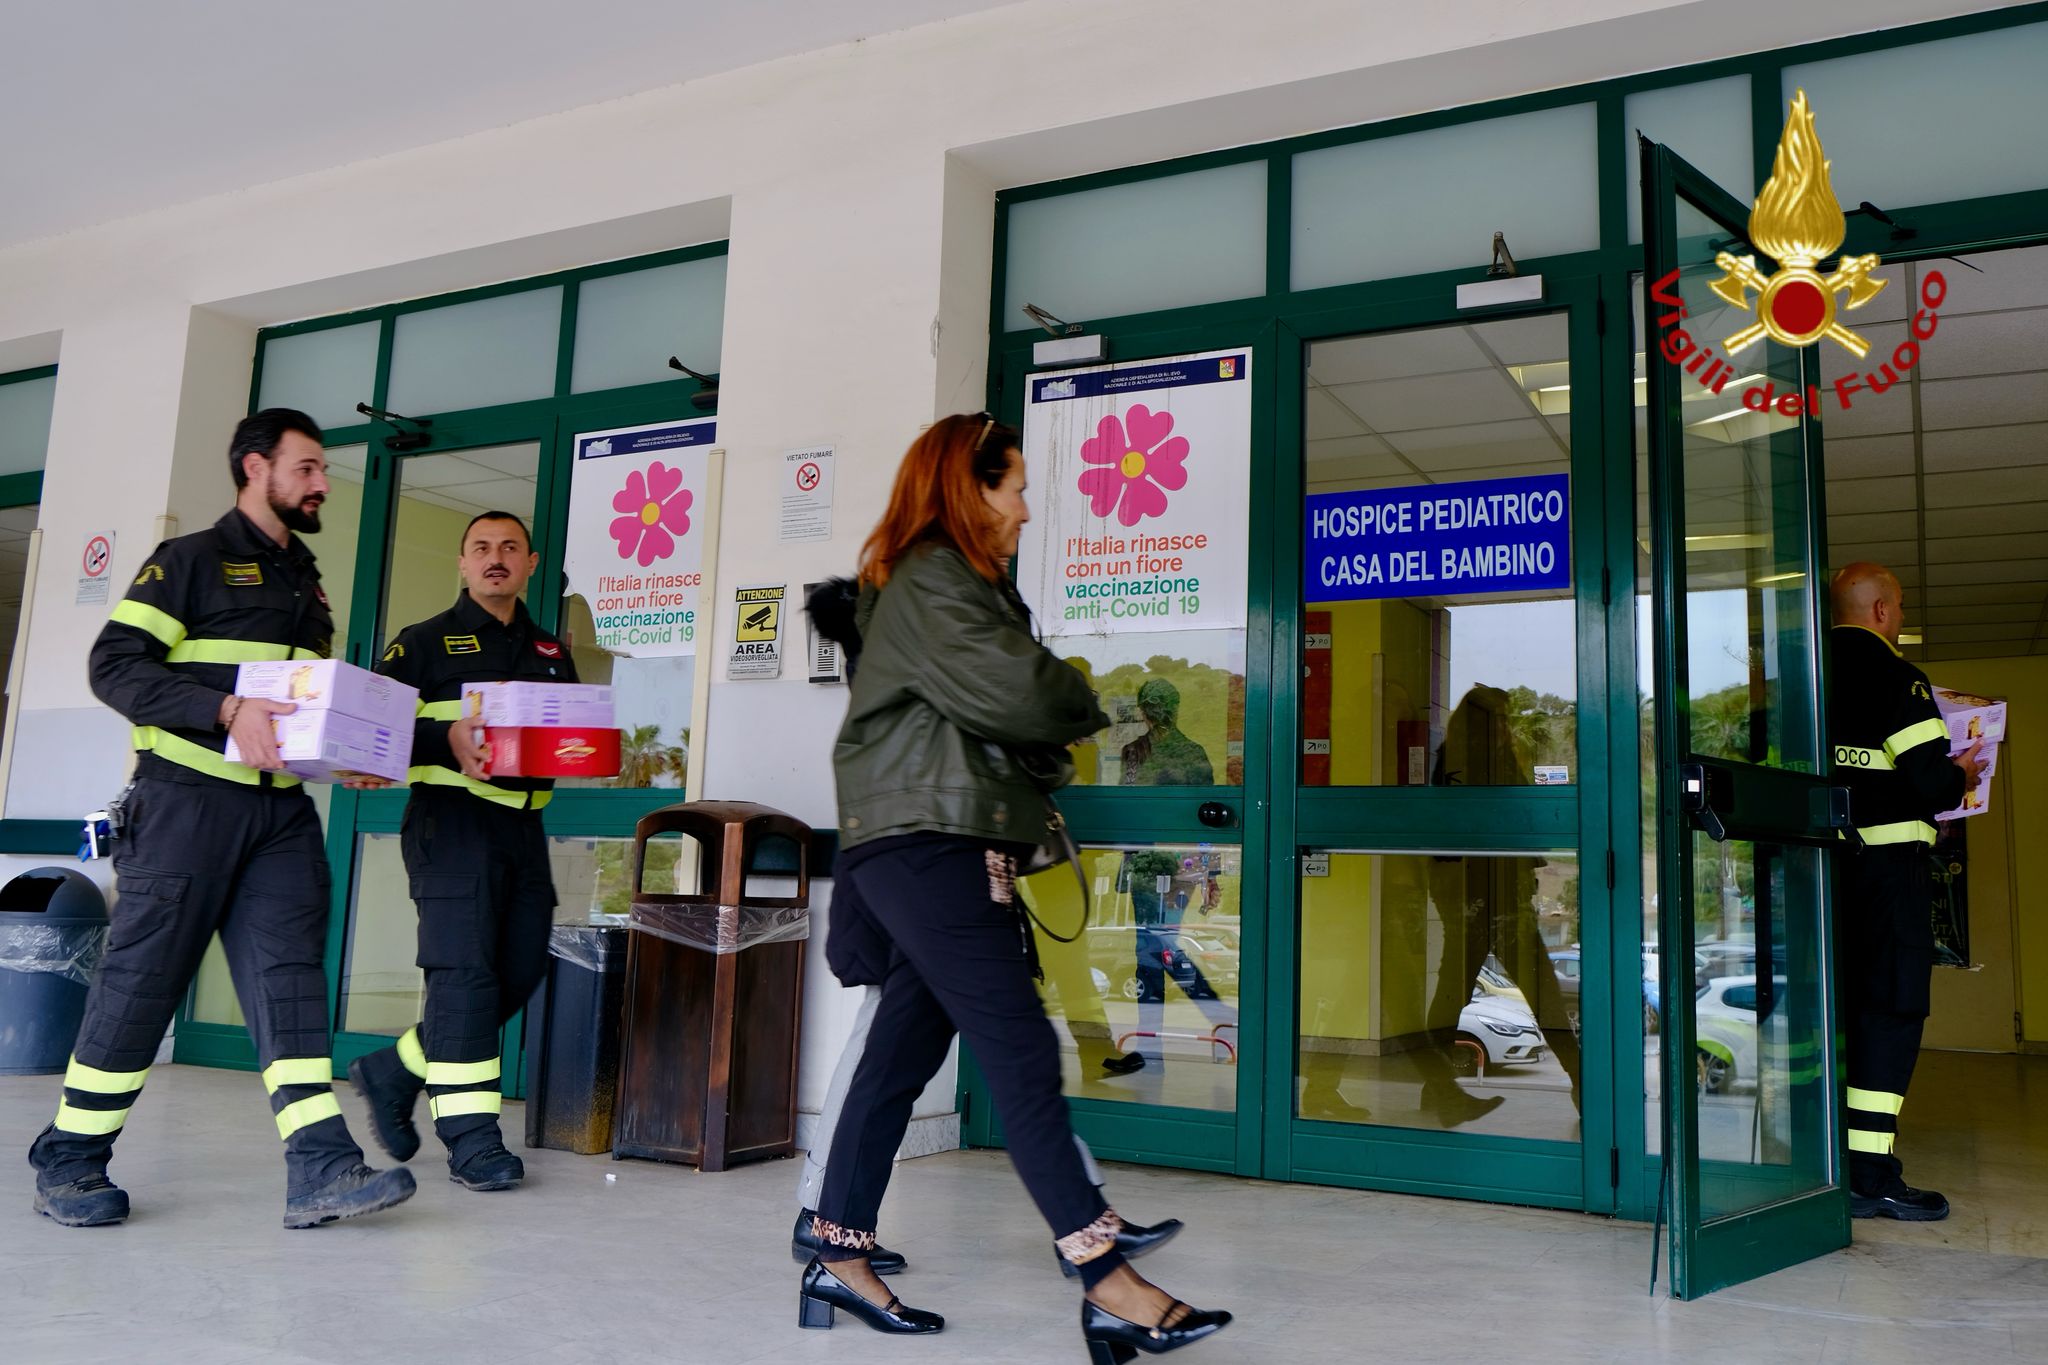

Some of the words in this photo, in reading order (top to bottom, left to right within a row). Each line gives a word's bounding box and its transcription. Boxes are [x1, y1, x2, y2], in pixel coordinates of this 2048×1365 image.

[786, 453, 809, 462] VIETATO
[809, 450, 833, 459] FUMARE
[1313, 502, 1412, 539] HOSPICE
[1419, 489, 1564, 531] PEDIATRICO
[1066, 535, 1125, 557] l'Italia
[1131, 533, 1208, 553] rinasce
[1065, 560, 1101, 578] con
[1106, 558, 1131, 576] un
[1136, 553, 1183, 574] fiore
[1320, 552, 1384, 587] CASA
[1389, 550, 1435, 583] DEL
[1441, 541, 1555, 580] BAMBINO
[598, 573, 641, 593] l'Italia
[645, 571, 701, 588] rinasce
[1064, 576, 1200, 598] vaccinazione
[597, 594, 623, 610] con
[626, 593, 645, 609] un
[648, 590, 683, 608] fiore
[736, 588, 784, 601] ATTENZIONE
[596, 609, 694, 629] vaccinazione
[1064, 596, 1170, 621] anti-Covid
[1178, 595, 1200, 615] 19
[595, 625, 671, 647] anti-Covid
[678, 624, 694, 642] 19
[730, 653, 778, 662] VIDEOSORVEGLIATA
[735, 643, 774, 655] AREA
